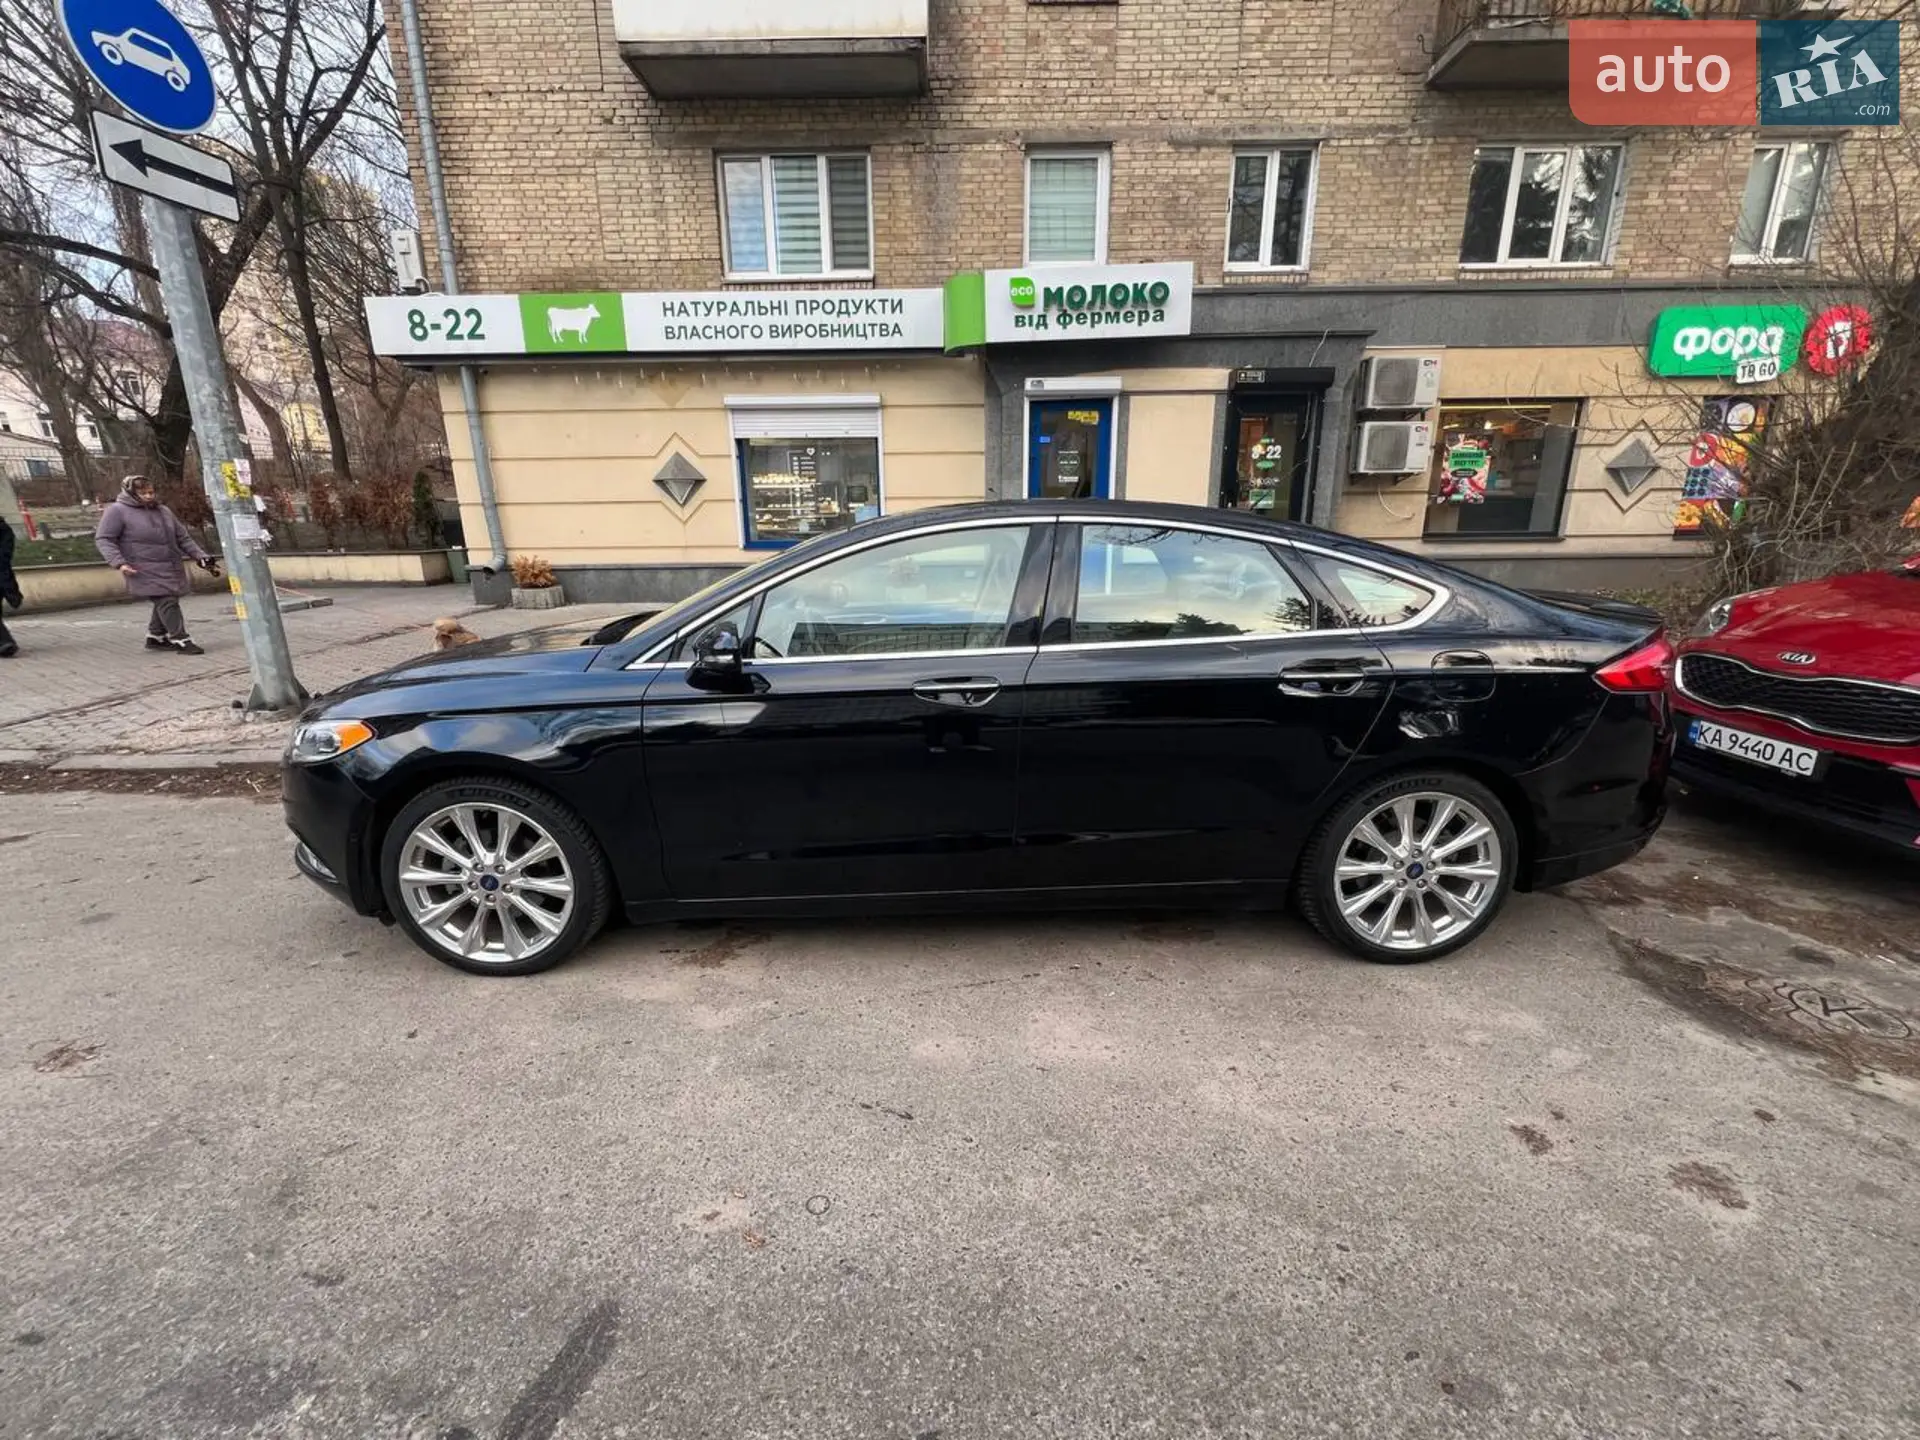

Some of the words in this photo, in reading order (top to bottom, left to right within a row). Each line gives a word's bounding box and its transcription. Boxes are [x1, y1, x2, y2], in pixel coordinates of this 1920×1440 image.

[1010, 286, 1033, 296] eco
[662, 300, 789, 317] НАТУРАЛЬНІ
[795, 298, 903, 318] ПРОДУКТИ
[407, 308, 486, 342] 8-22
[1014, 314, 1048, 330] від
[1056, 309, 1165, 331] фермера
[664, 324, 763, 340] ВЛАСНОГО
[769, 323, 903, 341] ВИРОБНИЦТВА
[1781, 652, 1809, 662] KIA
[1698, 724, 1722, 747] KA
[1728, 733, 1775, 761] 9440
[1778, 747, 1813, 771] AC
